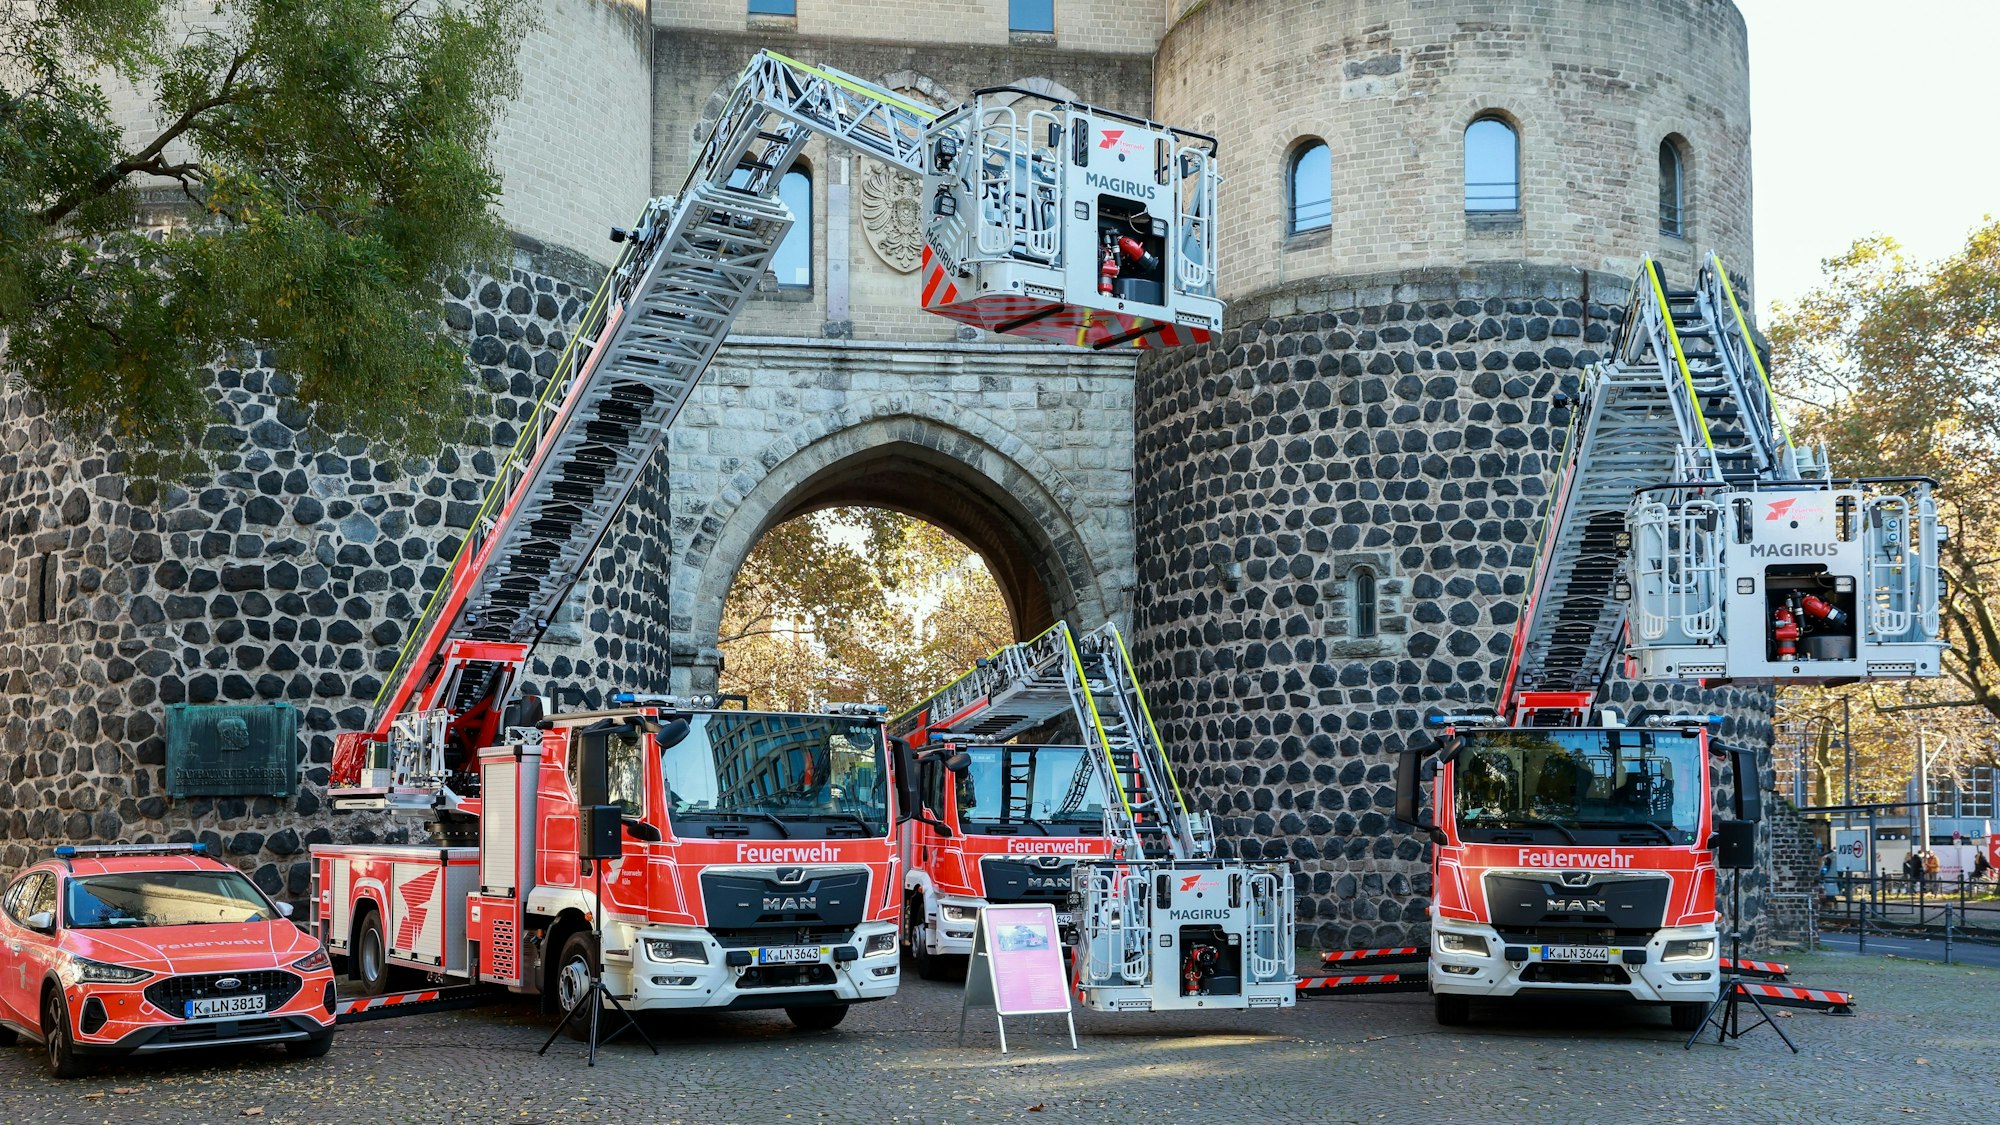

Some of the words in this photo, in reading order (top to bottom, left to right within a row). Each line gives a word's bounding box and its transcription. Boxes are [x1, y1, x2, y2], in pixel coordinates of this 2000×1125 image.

[1086, 172, 1155, 199] MAGIRUS
[925, 227, 957, 277] MAGIRUS
[1750, 543, 1838, 557] MAGIRUS
[736, 842, 841, 862] Feuerwehr
[1007, 838, 1092, 853] Feuerwehr
[1838, 844, 1853, 855] KVB
[1518, 849, 1634, 867] Feuerwehr
[1027, 877, 1071, 888] MAN
[763, 896, 816, 911] MAN
[1546, 899, 1606, 912] MAN
[1056, 915, 1072, 924] 642
[1169, 909, 1231, 920] MAGIRUS
[156, 938, 265, 951] Feuerwehr
[767, 949, 773, 961] K
[1549, 948, 1556, 958] K
[194, 1001, 202, 1014] K
